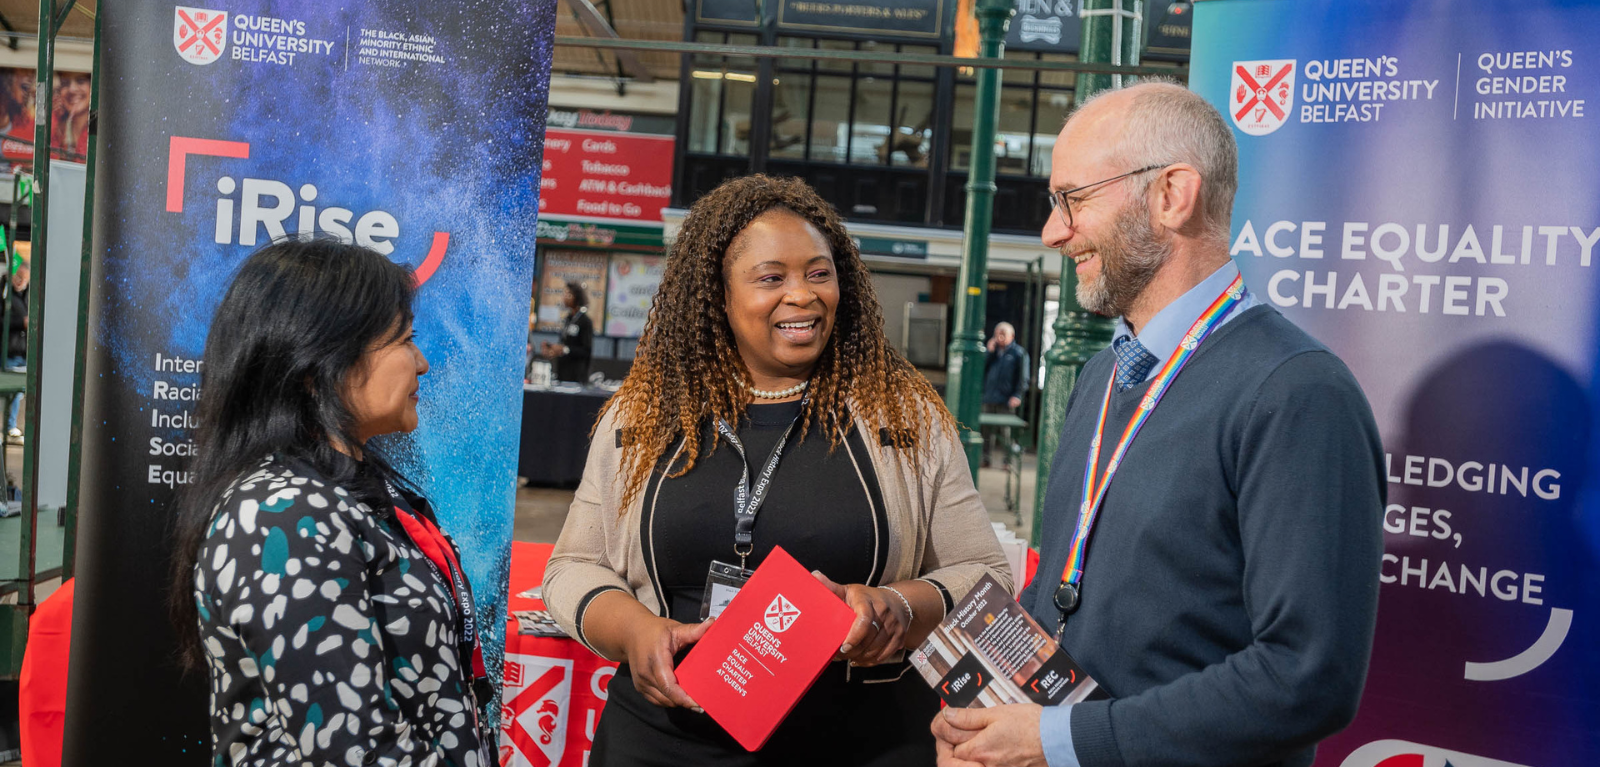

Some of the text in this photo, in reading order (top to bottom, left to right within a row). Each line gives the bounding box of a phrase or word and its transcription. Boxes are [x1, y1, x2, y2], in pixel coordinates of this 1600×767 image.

[234, 14, 306, 35] QUEEN'S
[232, 31, 335, 55] UNIVERSITY
[360, 28, 437, 46] THE BLACK, ASIAN,
[360, 38, 434, 53] MINORITY ETHNIC
[232, 47, 296, 66] BELFAST
[359, 47, 445, 64] AND INTERNATIONAL
[359, 57, 400, 68] NETWORK
[1477, 50, 1573, 74] QUEEN'S
[1304, 55, 1398, 81] QUEEN'S
[1302, 79, 1439, 103] UNIVERSITY
[1475, 75, 1566, 95] GENDER
[1300, 103, 1384, 123] BELFAST
[1474, 100, 1585, 119] INITIATIVE
[582, 138, 617, 153] Cards
[582, 159, 630, 176] Tobacco
[215, 176, 399, 256] iRise
[1230, 219, 1600, 271] ACE EQUALITY
[1267, 269, 1509, 317] CHARTER
[155, 352, 204, 373] Inter
[153, 381, 202, 401] Racia
[151, 409, 200, 428] Inclu
[149, 437, 198, 456] Socia
[148, 464, 197, 489] Equa
[756, 478, 770, 496] Expo
[1385, 453, 1561, 500] LEDGING
[745, 496, 761, 515] 2022
[1383, 503, 1462, 549] GES,
[1379, 553, 1545, 605] CHANGE
[461, 591, 471, 615] Expo
[957, 599, 977, 620] History
[974, 581, 993, 600] Month
[463, 617, 474, 642] 2022
[960, 610, 978, 628] October
[743, 633, 769, 657] BELFAST
[748, 627, 787, 663] UNIVERSITY
[753, 622, 781, 648] QUEEN'S
[732, 648, 748, 664] RACE
[722, 661, 747, 686] CHARTER
[727, 654, 754, 680] EQUALITY
[716, 668, 747, 697] AT QUEEN'S
[951, 672, 971, 693] iRise
[1040, 670, 1059, 689] REC
